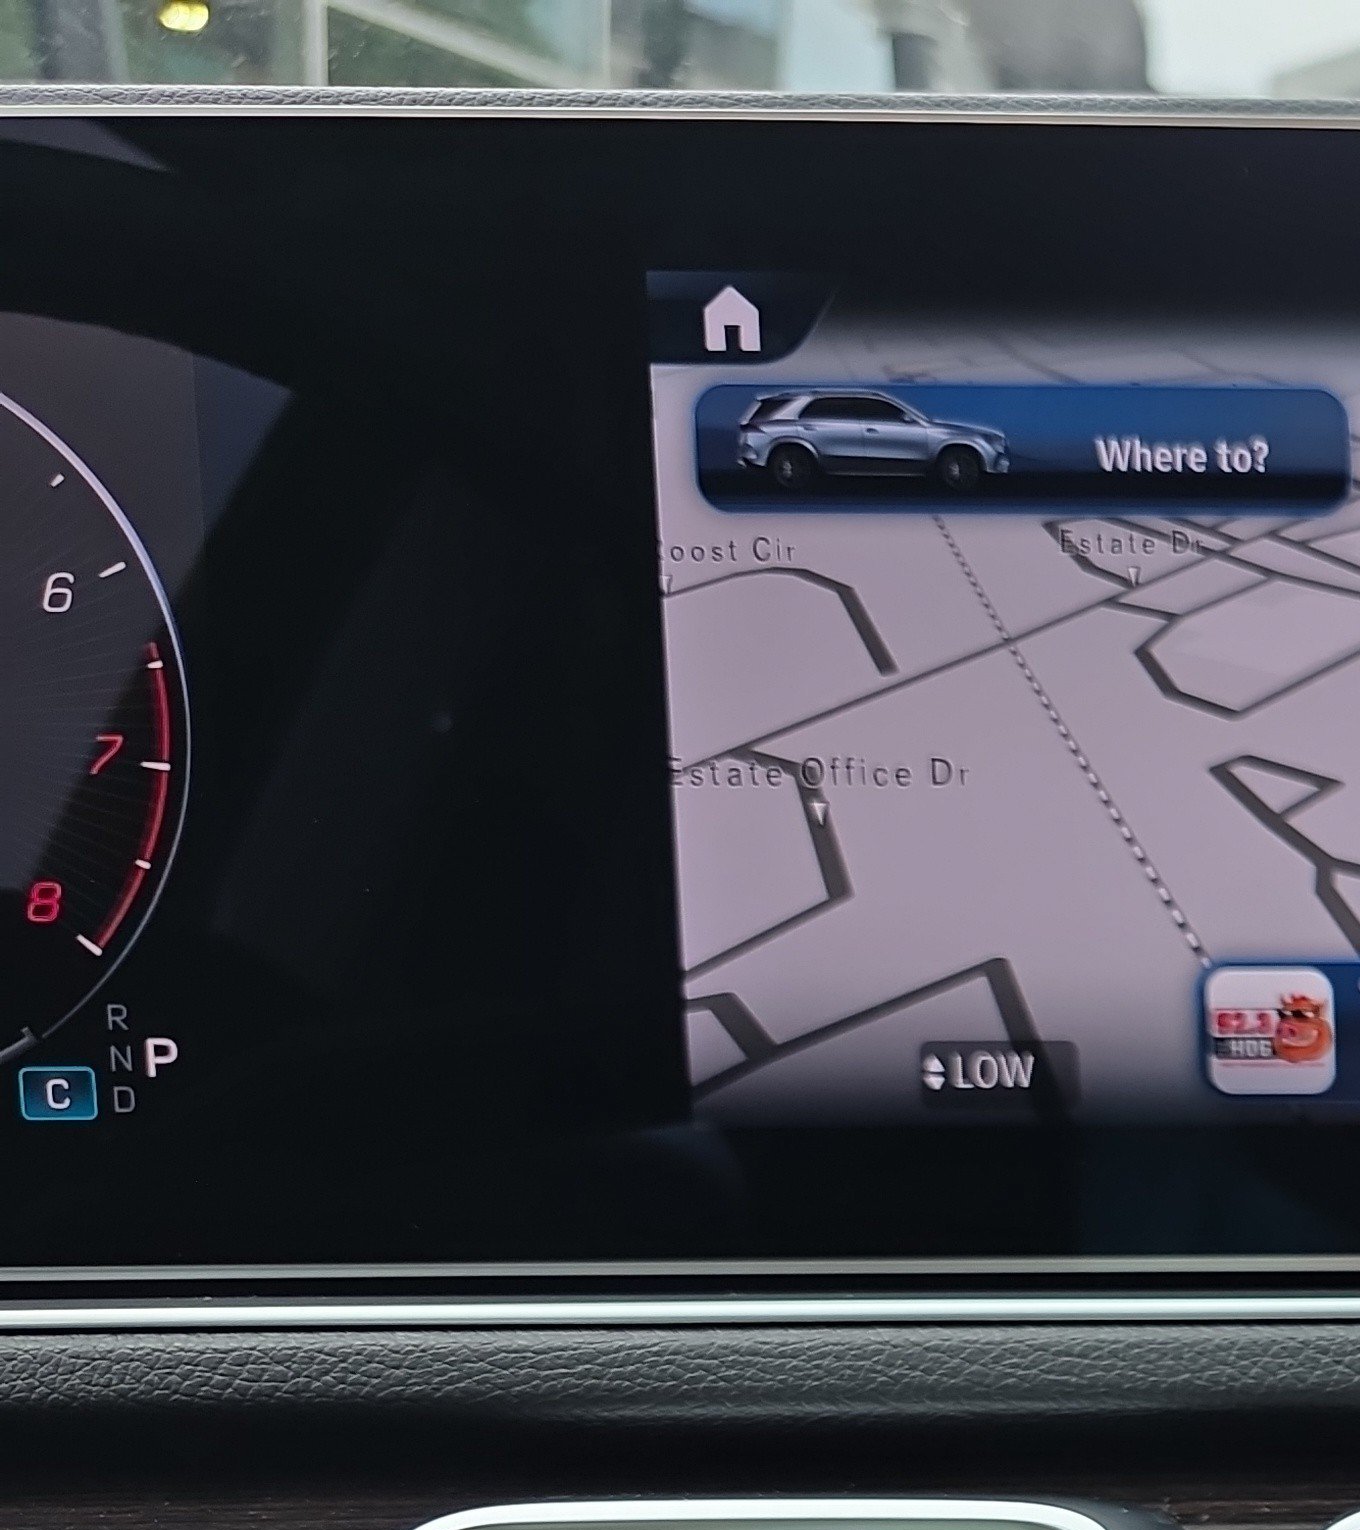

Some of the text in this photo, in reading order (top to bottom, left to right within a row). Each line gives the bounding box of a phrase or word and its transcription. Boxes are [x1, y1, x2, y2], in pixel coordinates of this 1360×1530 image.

[1095, 435, 1270, 473] Where to?
[660, 536, 797, 563] oost Cir
[1059, 528, 1204, 556] Estate Dr
[42, 571, 75, 613] 6
[90, 733, 123, 775] 7
[668, 756, 970, 789] Estate Office Dr
[26, 882, 62, 922] 8
[107, 1004, 129, 1031] R
[109, 1046, 134, 1073] N
[144, 1037, 179, 1078] P
[951, 1051, 1035, 1090] LOW
[45, 1079, 71, 1110] C
[113, 1086, 136, 1114] D
